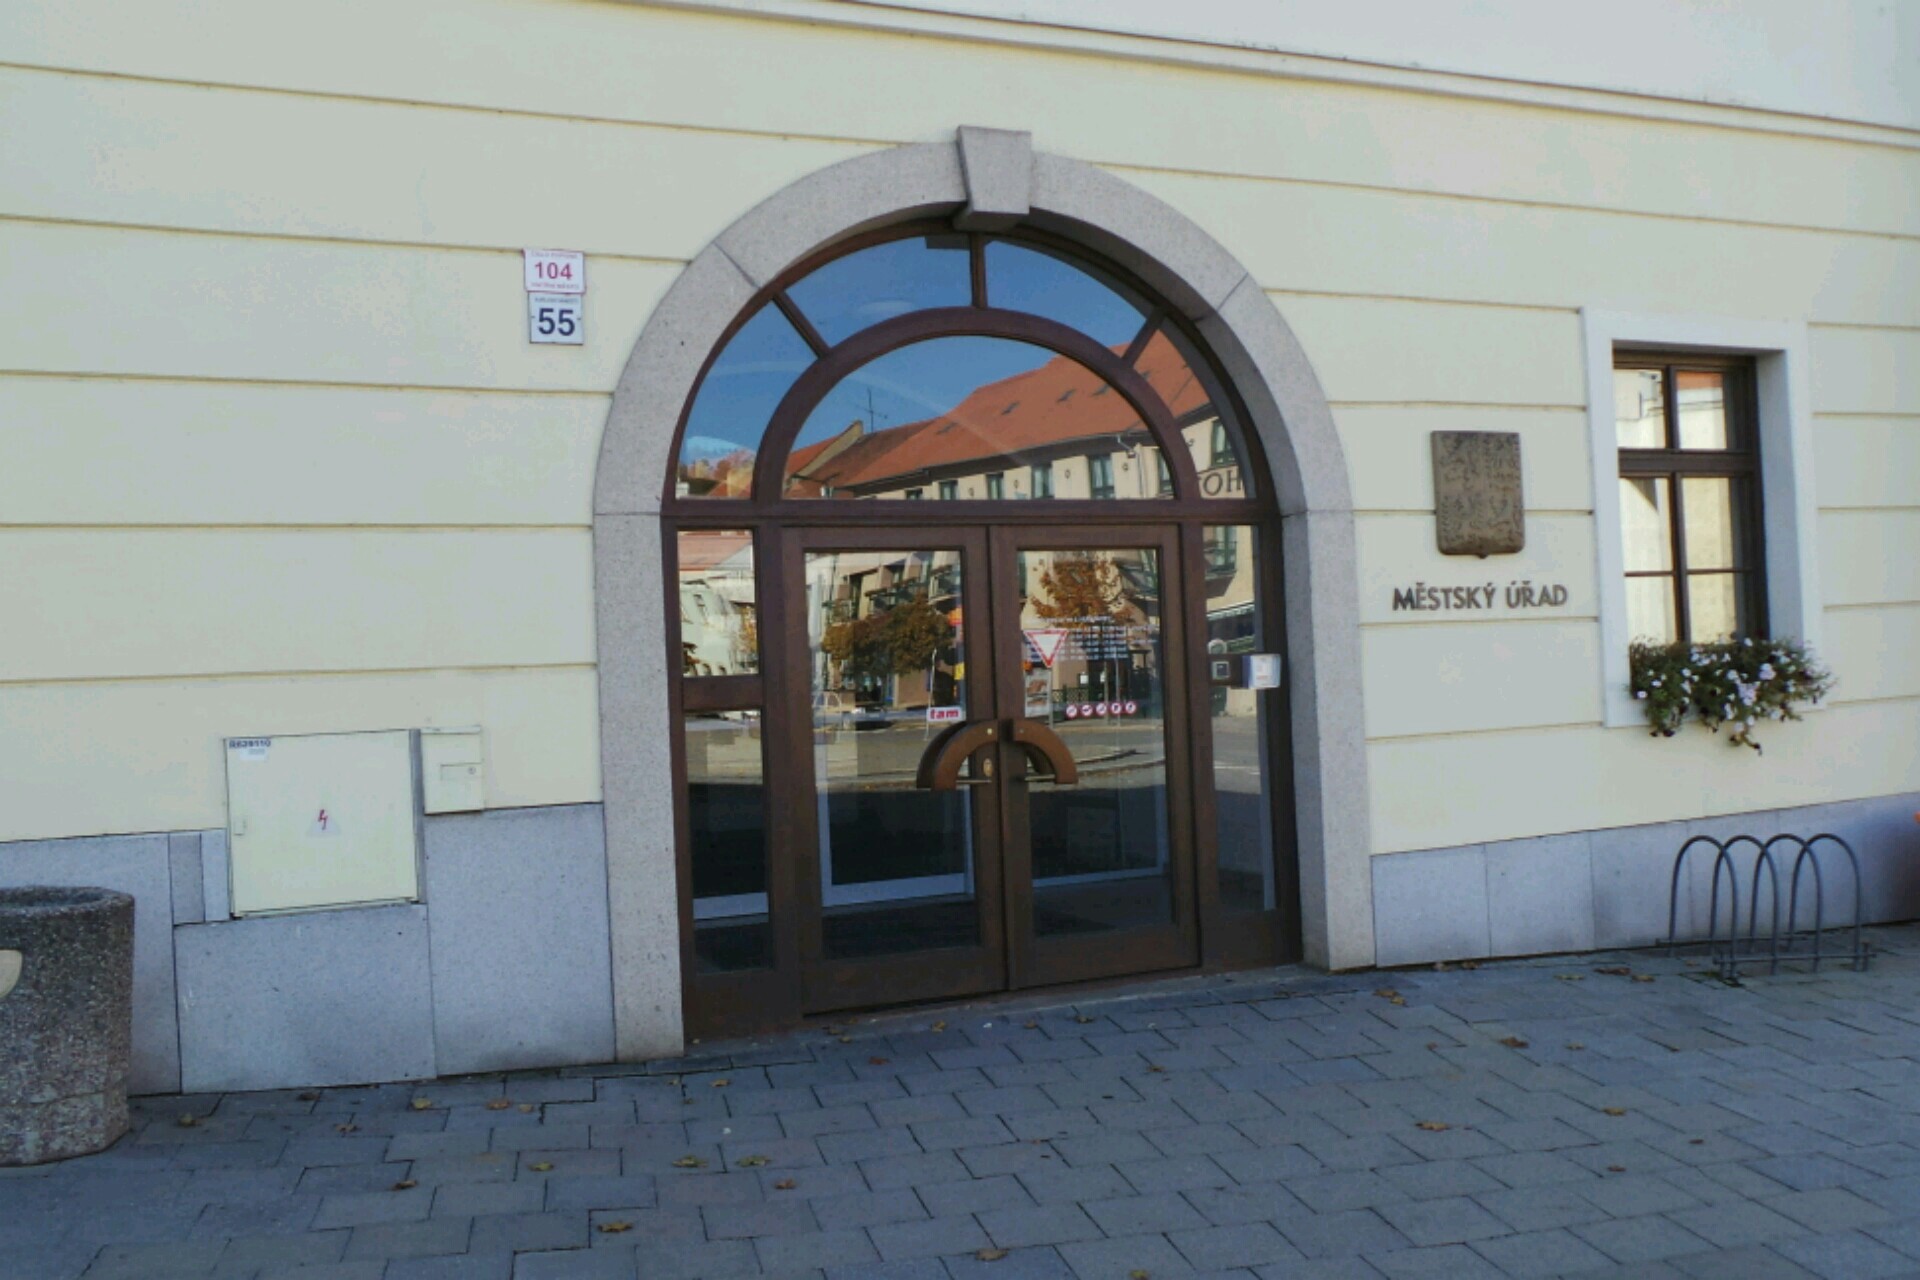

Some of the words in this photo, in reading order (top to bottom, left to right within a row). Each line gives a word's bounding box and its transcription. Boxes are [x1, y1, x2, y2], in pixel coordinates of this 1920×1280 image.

[535, 262, 572, 279] 104
[538, 307, 575, 336] 55
[1392, 582, 1496, 611] MĚSTSKÝ
[1504, 580, 1568, 608] ÚŘAD
